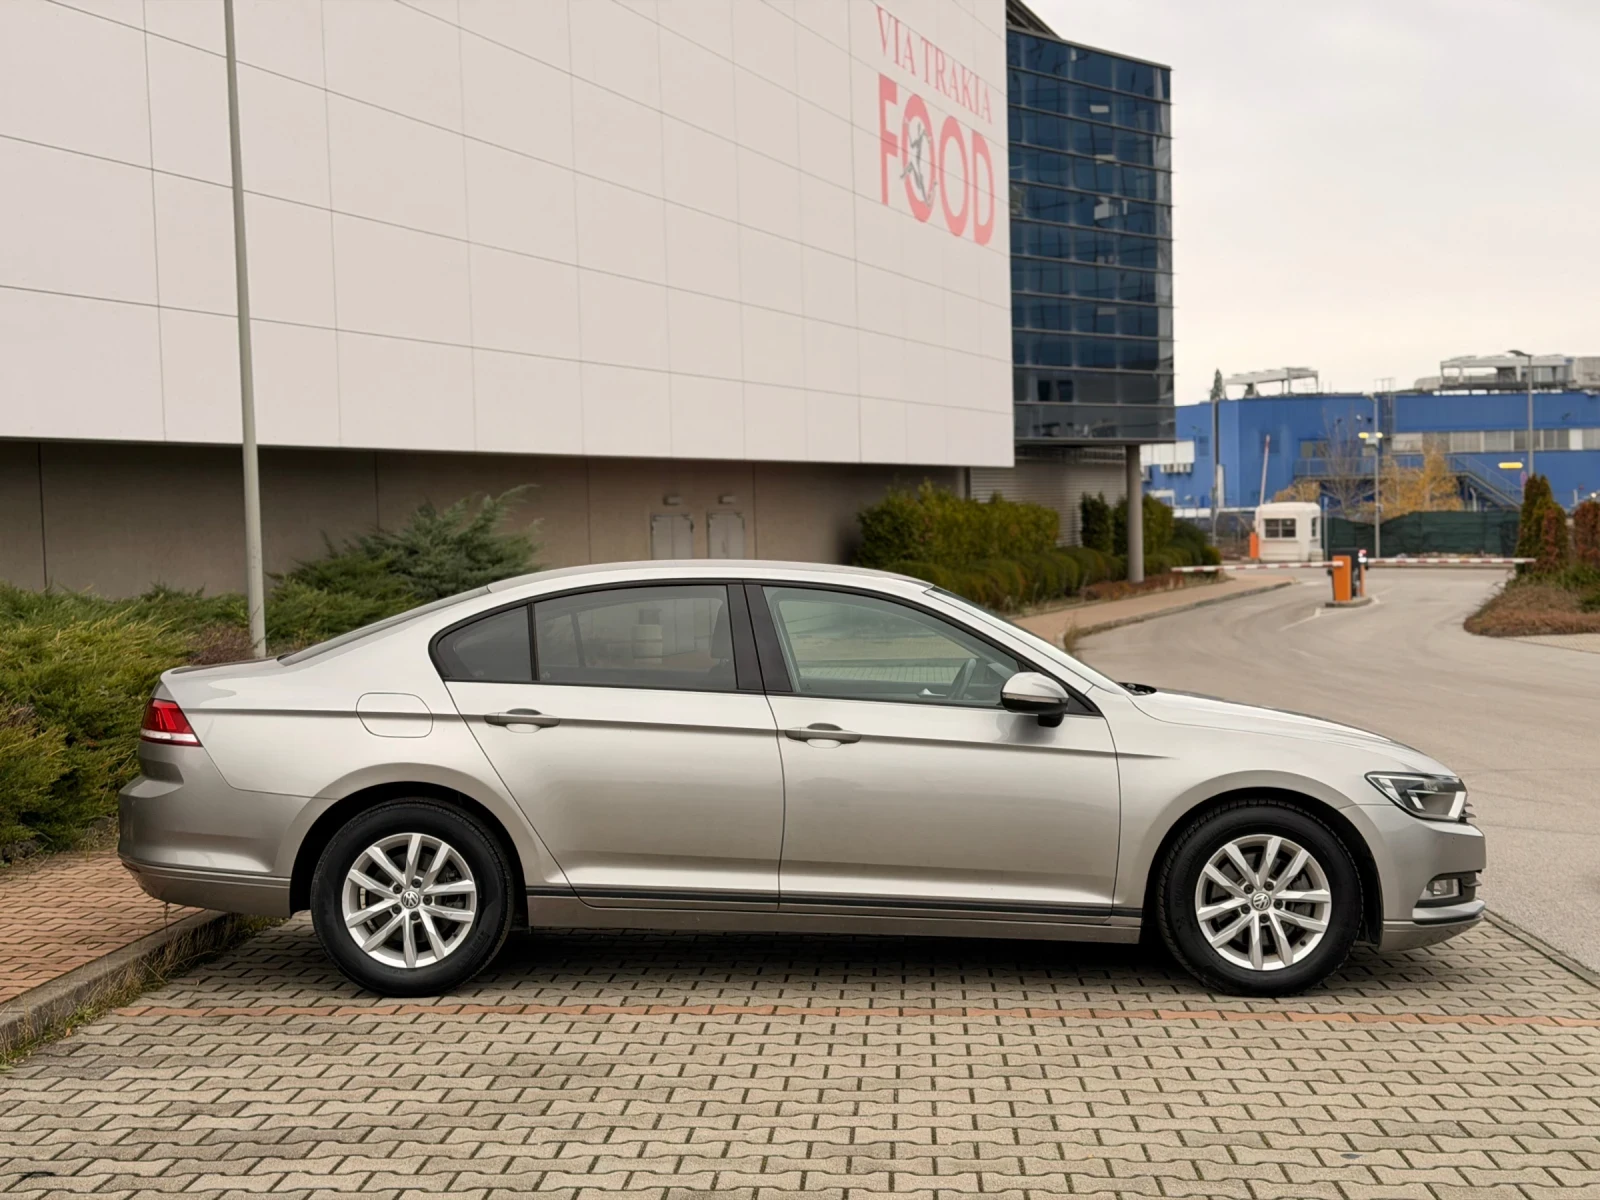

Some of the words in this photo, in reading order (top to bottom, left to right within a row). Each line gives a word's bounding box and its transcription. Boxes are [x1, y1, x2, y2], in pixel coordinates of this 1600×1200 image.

[877, 5, 916, 77] VIA
[921, 36, 992, 125] TRAKIA
[878, 72, 995, 246] FOOD
